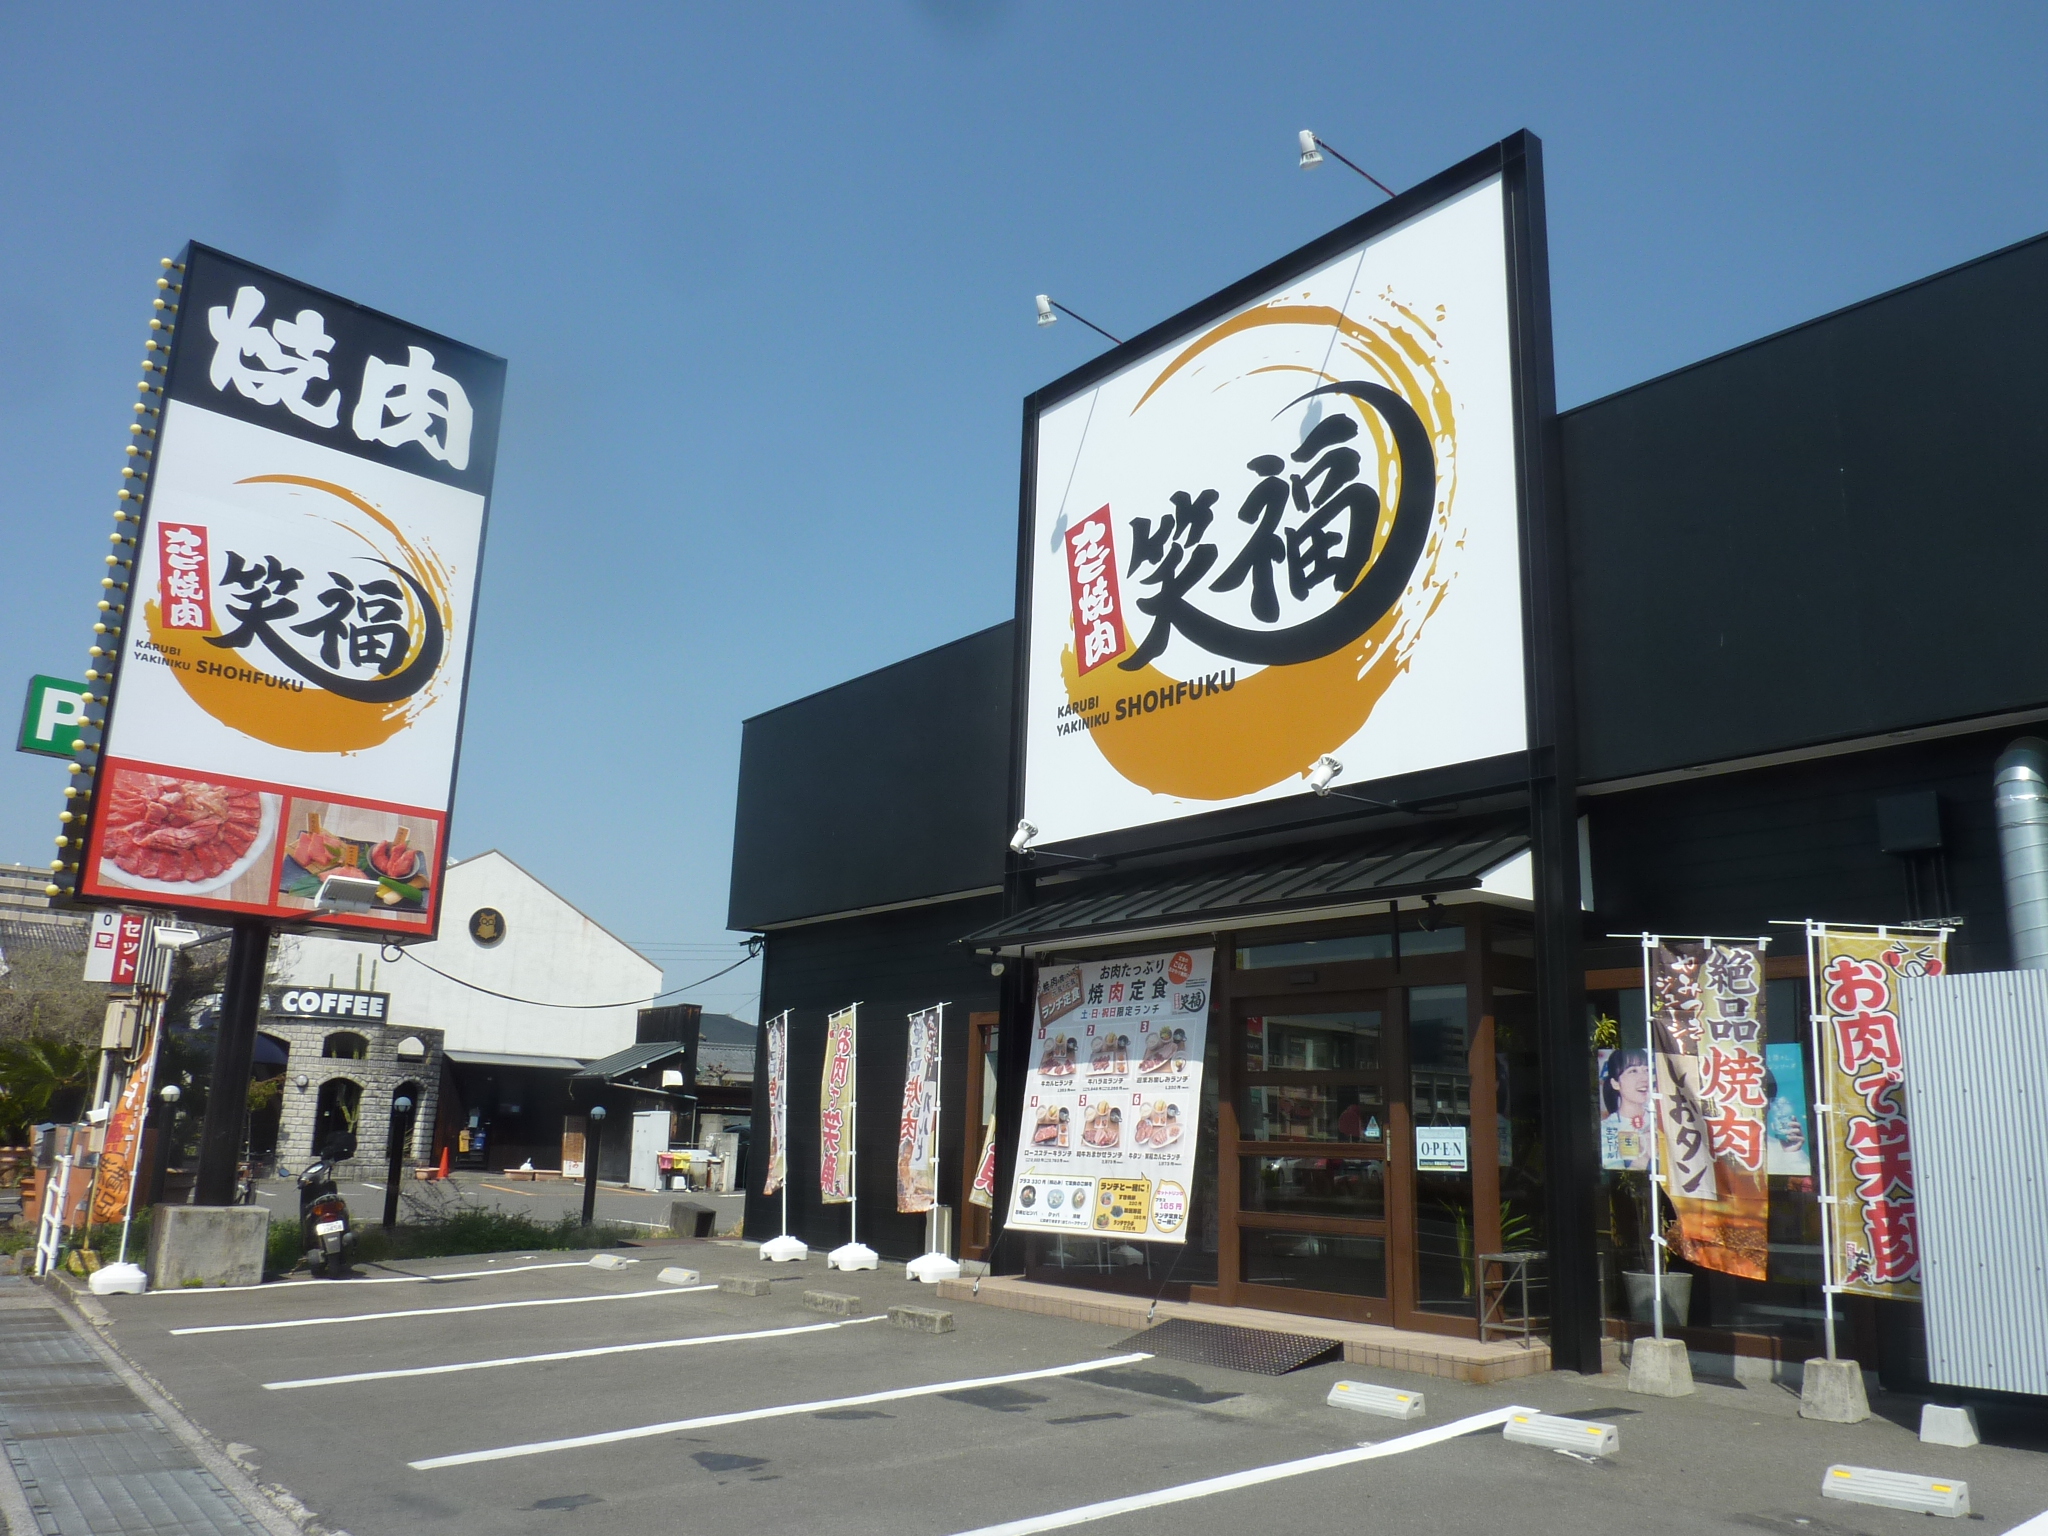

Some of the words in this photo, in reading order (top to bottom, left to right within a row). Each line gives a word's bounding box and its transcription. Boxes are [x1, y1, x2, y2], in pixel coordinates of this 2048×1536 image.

[207, 286, 475, 472] 焼肉
[1119, 380, 1437, 670] 笑福
[135, 639, 181, 657] KARUBI
[202, 550, 443, 704] 笑福
[133, 651, 191, 671] YAKINIKU
[195, 659, 304, 693] SHOHFUKU
[1056, 711, 1110, 737] YAKINIKU
[1115, 667, 1236, 721] SHOHFUKU
[35, 686, 86, 741] P
[1057, 695, 1100, 719] KARUBI
[1087, 975, 1169, 1005] 焼肉定食
[1099, 958, 1165, 980] お肉たっぷり
[1671, 954, 1704, 1042] やみつき
[281, 990, 385, 1018] COFFEE
[1041, 986, 1081, 1019] ランチ定食
[1655, 975, 1687, 1057] ジューシー
[1700, 948, 1767, 1172] 絶品焼肉
[1666, 1056, 1708, 1194] しおタン
